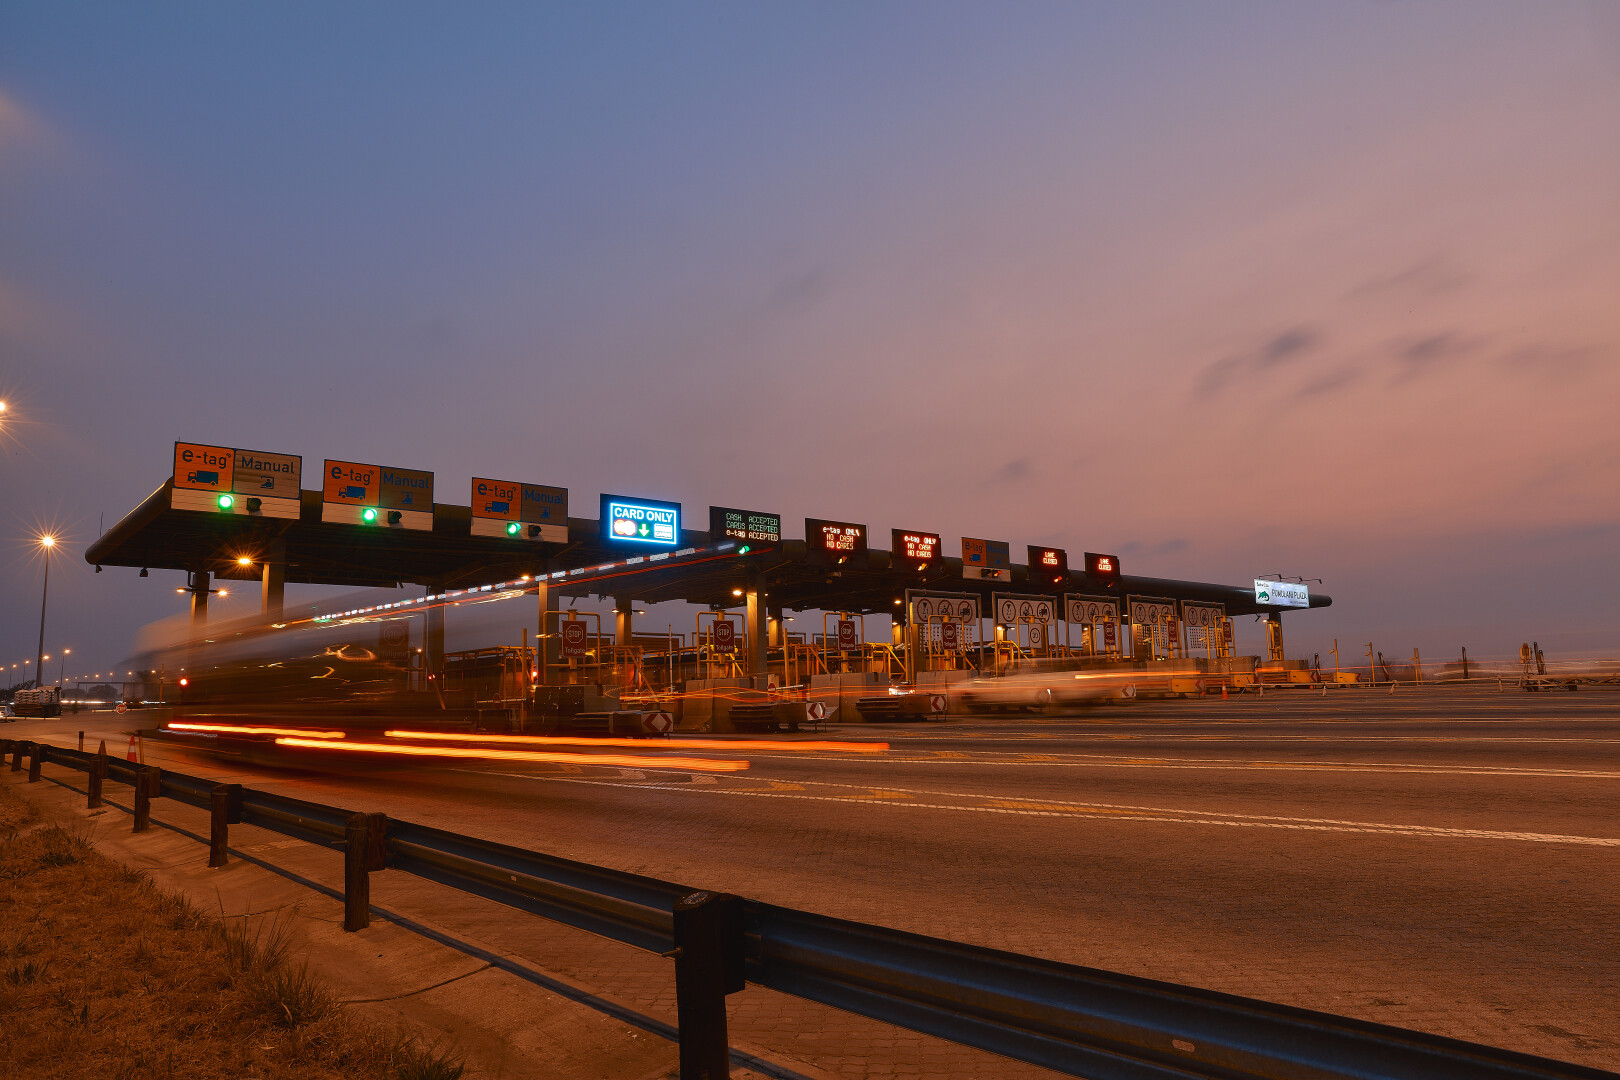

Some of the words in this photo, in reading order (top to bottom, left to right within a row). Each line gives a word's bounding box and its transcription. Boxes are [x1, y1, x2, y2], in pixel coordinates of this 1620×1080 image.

[182, 449, 227, 469] e-tag
[241, 456, 294, 474] Manual
[331, 466, 371, 486] e-tag
[383, 472, 429, 489] Manual
[477, 483, 514, 501] e-tag
[525, 489, 563, 504] Manual
[614, 507, 645, 520] CARD
[646, 511, 673, 523] ONLY
[726, 512, 742, 521] CASH
[748, 515, 778, 526] ACCEPTED
[726, 520, 746, 530] CARDS
[748, 523, 778, 533] ACCEPTED
[726, 529, 746, 538] e-tag
[748, 531, 779, 541] ACCEPTED
[568, 629, 582, 638] STOP
[718, 628, 730, 636] STOP
